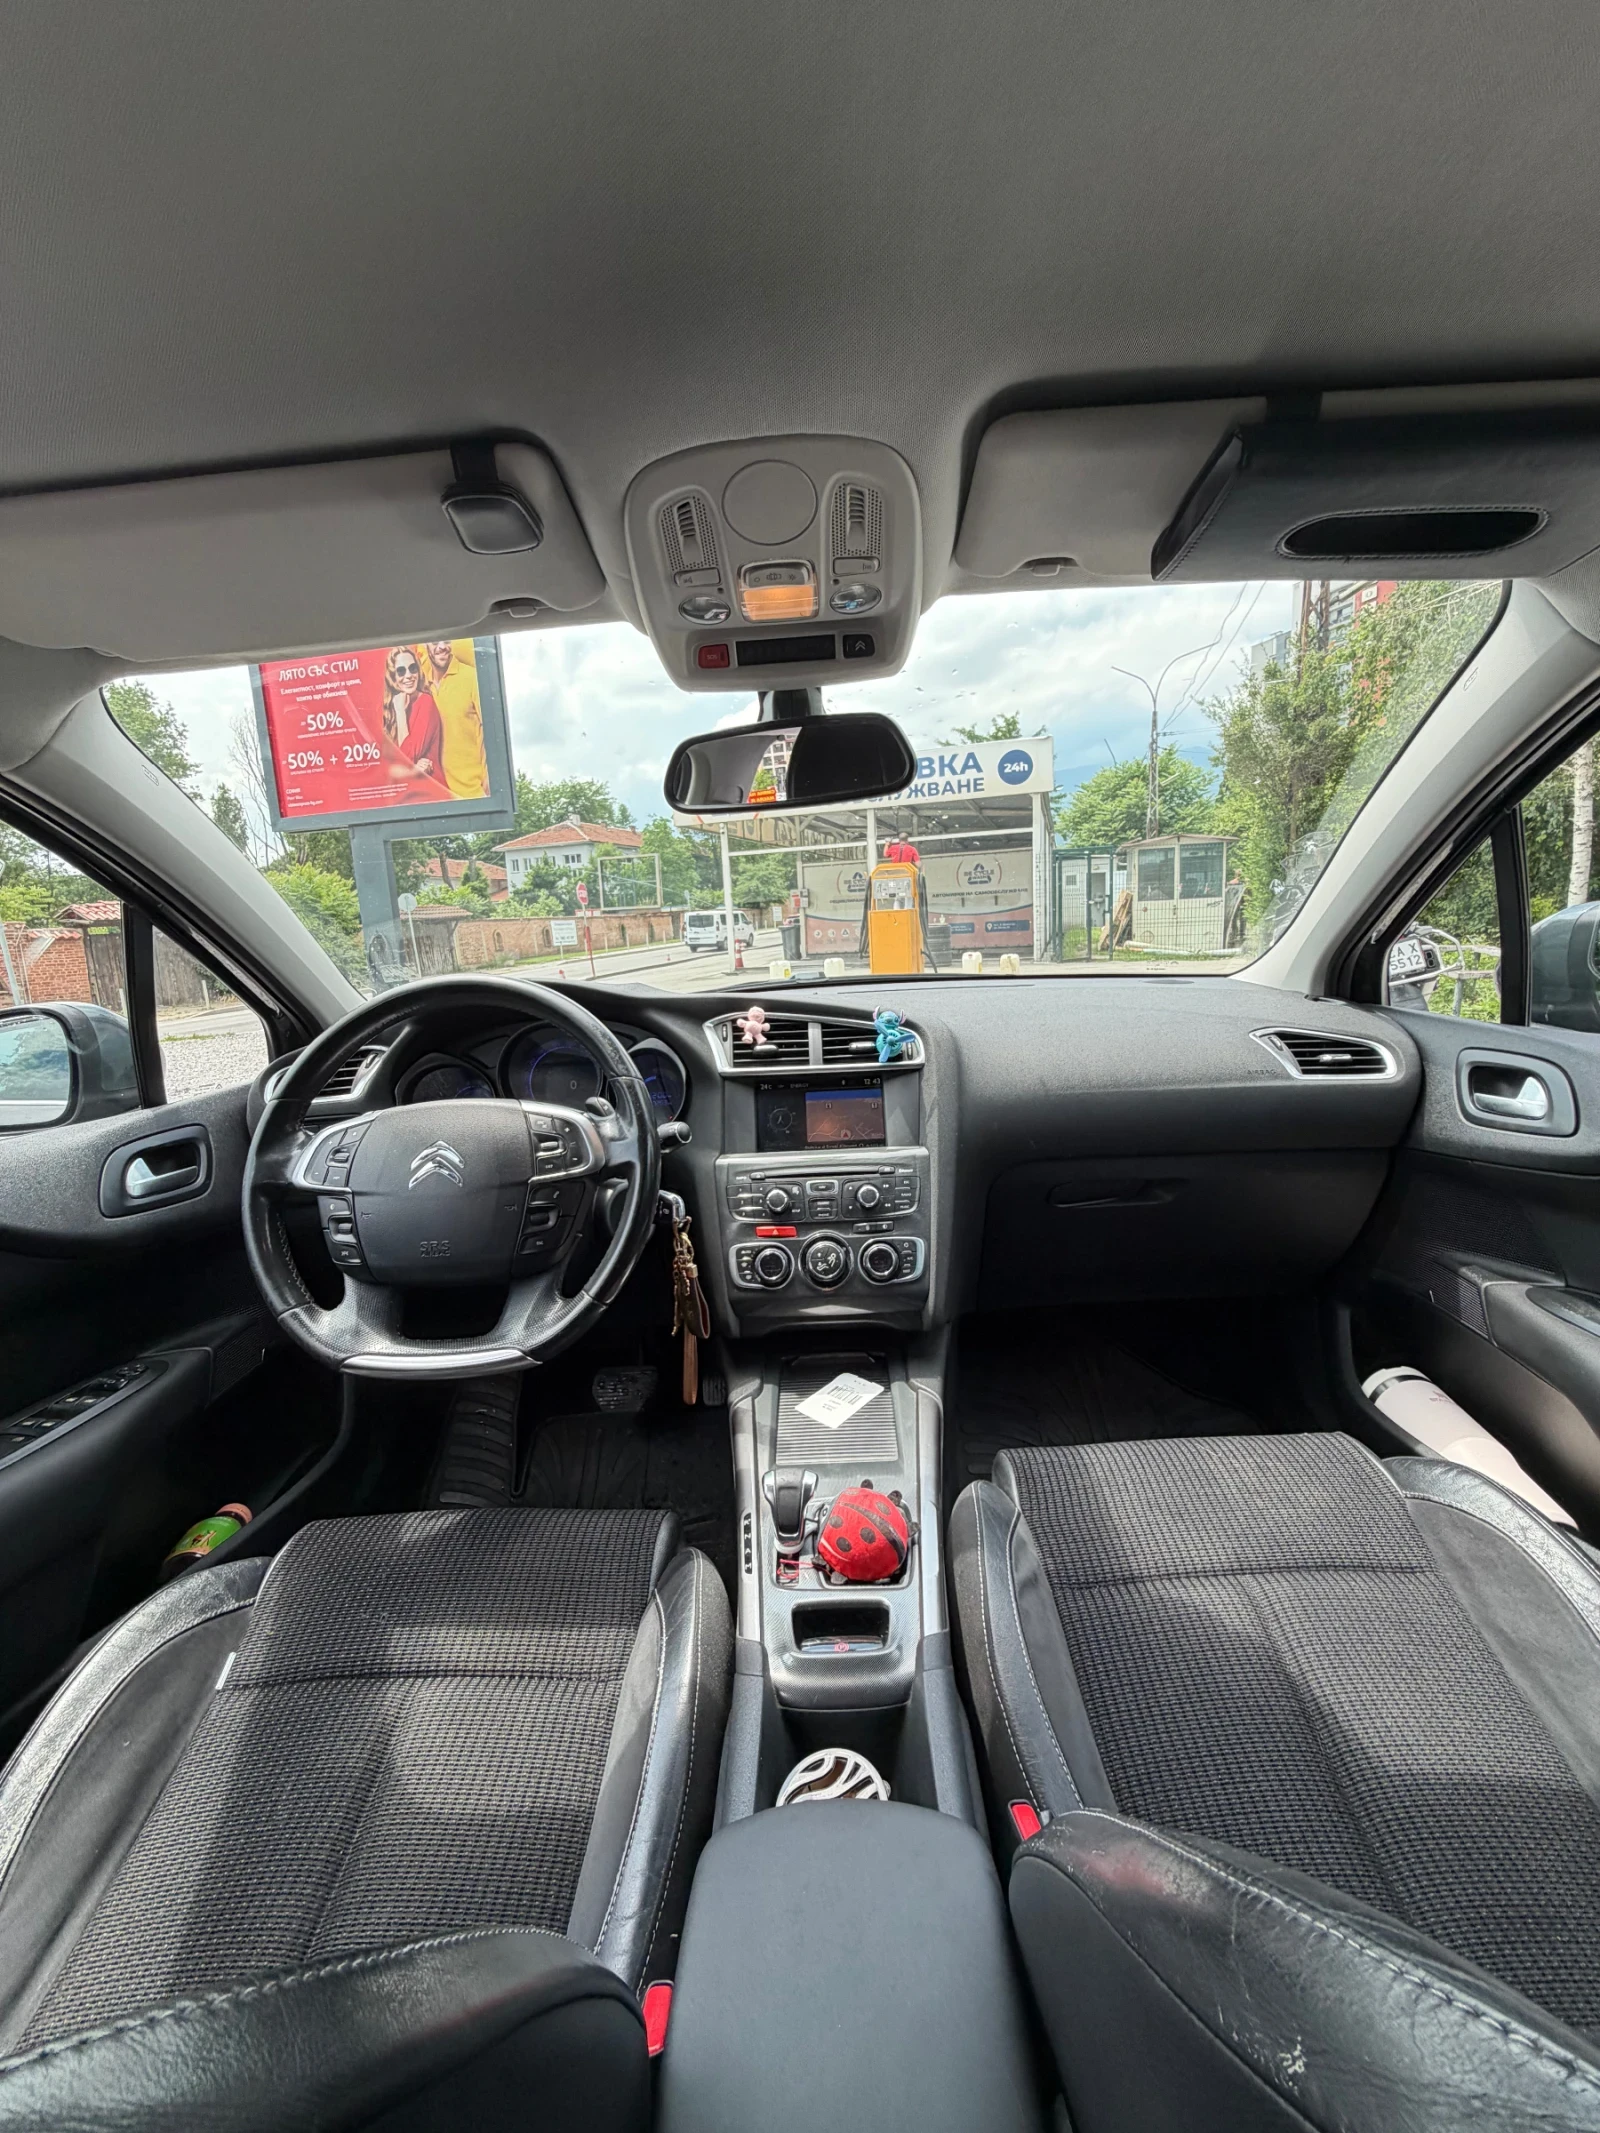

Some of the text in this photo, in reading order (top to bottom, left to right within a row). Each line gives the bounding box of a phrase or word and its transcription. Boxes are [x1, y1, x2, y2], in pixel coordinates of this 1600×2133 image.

[706, 653, 718, 661] SOS
[279, 658, 359, 682] ЛЯТО СЪС СТИЛ
[329, 754, 338, 765] +
[343, 742, 381, 763] 20%
[916, 752, 984, 780] ВКА
[1003, 761, 1029, 773] 24h
[1390, 954, 1423, 971] 5512
[420, 1240, 450, 1251] SRS
